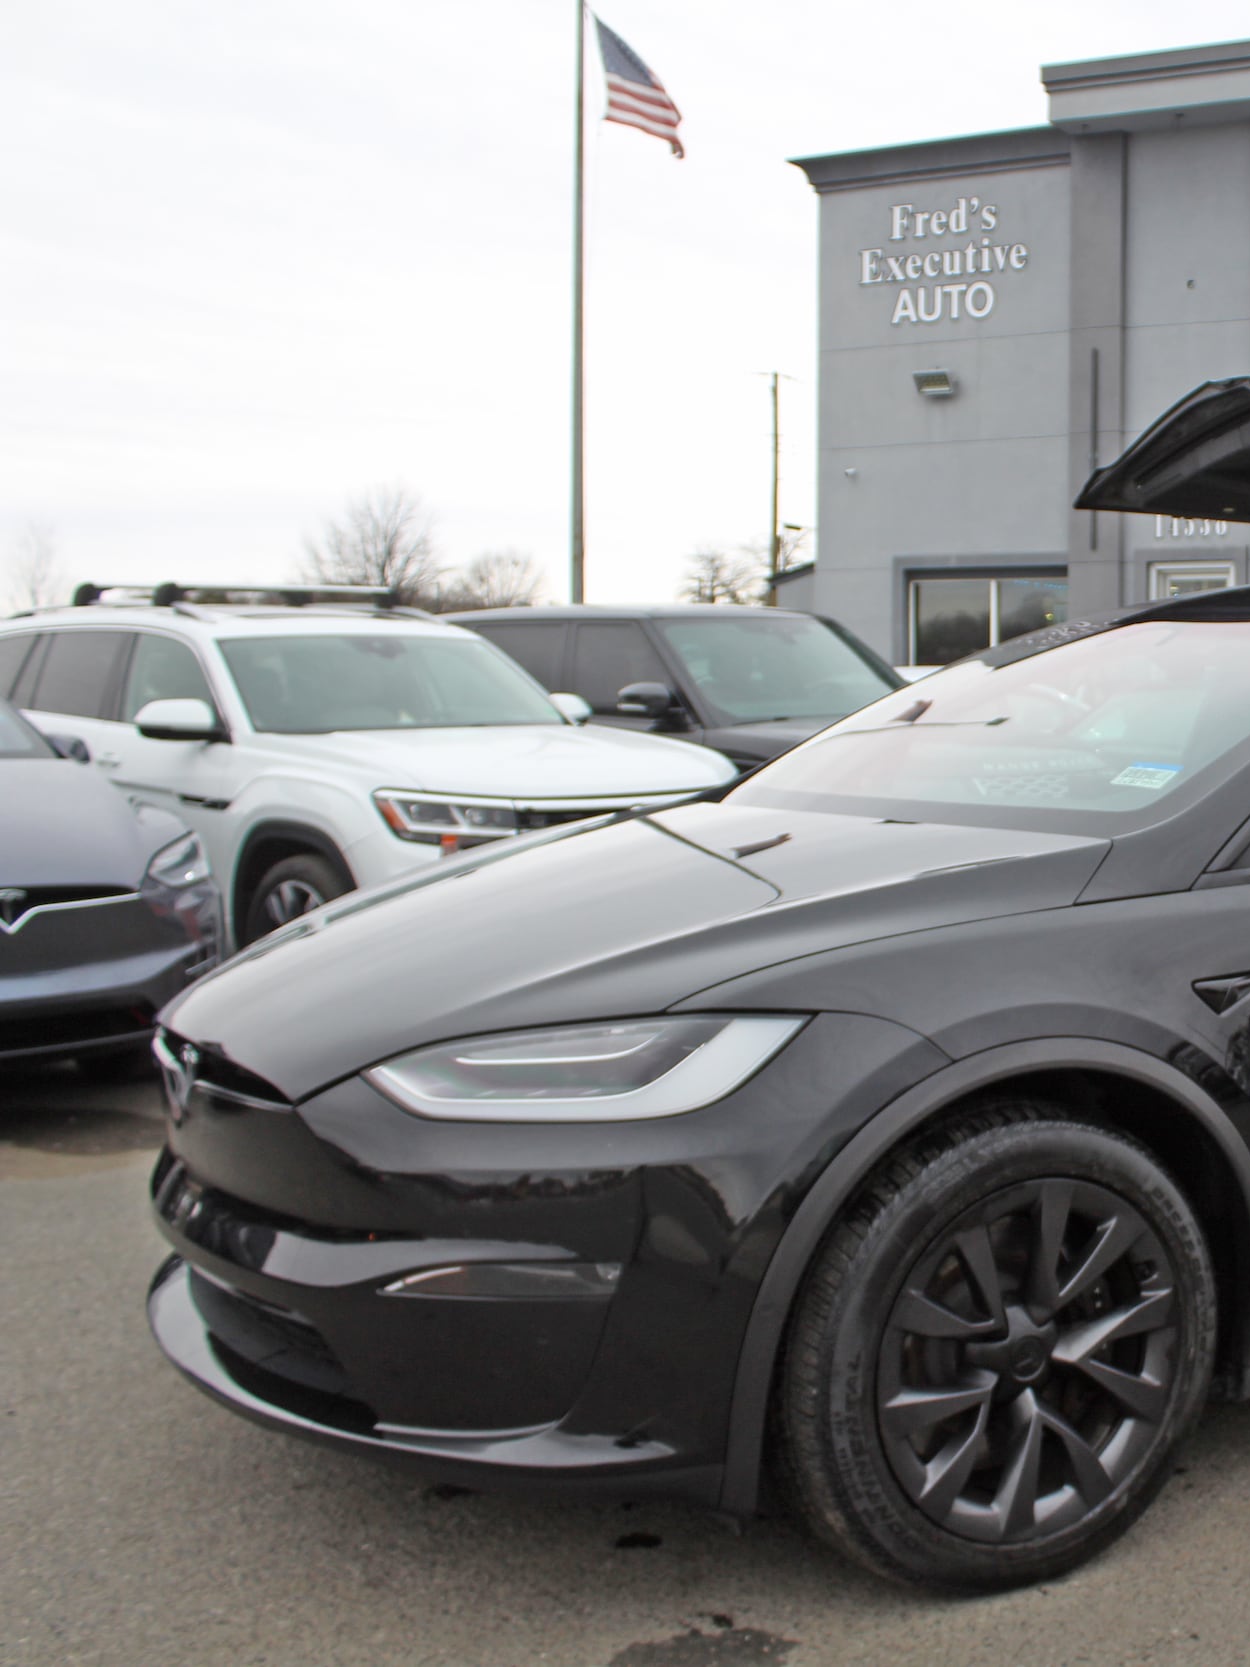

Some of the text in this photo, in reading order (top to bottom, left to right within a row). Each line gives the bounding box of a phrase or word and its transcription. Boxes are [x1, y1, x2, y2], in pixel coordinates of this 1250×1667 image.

[891, 196, 997, 240] Fred's
[860, 238, 1027, 285] Executive
[892, 280, 994, 325] AUTO
